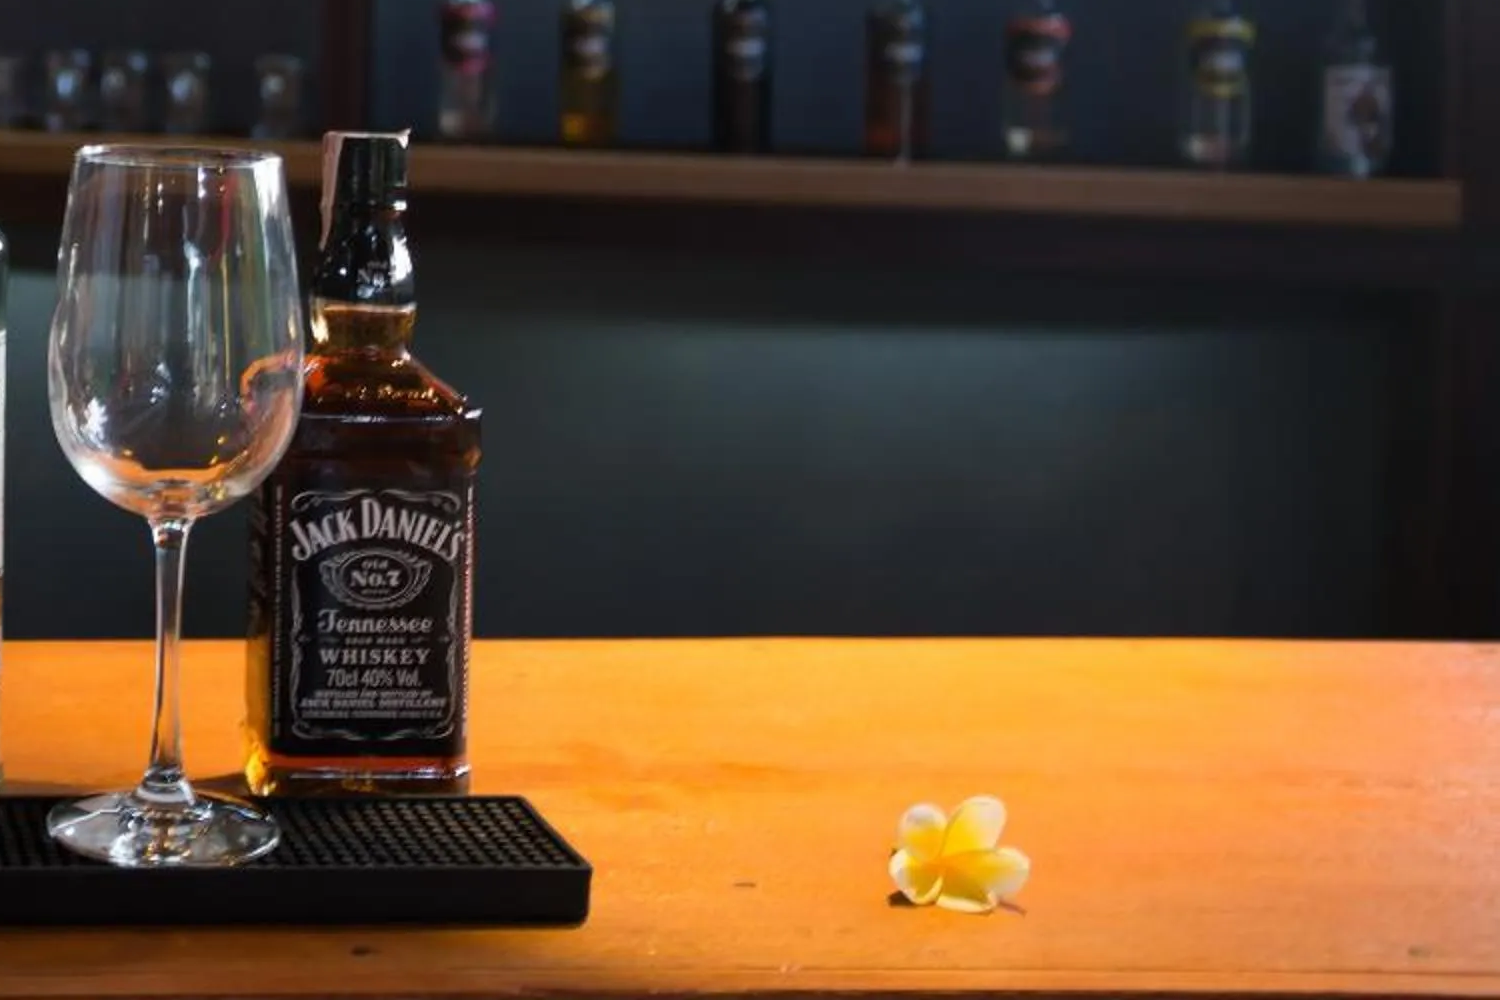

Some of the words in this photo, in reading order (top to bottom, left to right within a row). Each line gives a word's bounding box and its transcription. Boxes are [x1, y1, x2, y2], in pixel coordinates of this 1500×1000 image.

[289, 509, 357, 562] JACK
[360, 497, 465, 562] DANIEL'S
[316, 609, 434, 634] Tennessee
[319, 648, 431, 666] WHISKEY
[325, 667, 358, 688] 70cl
